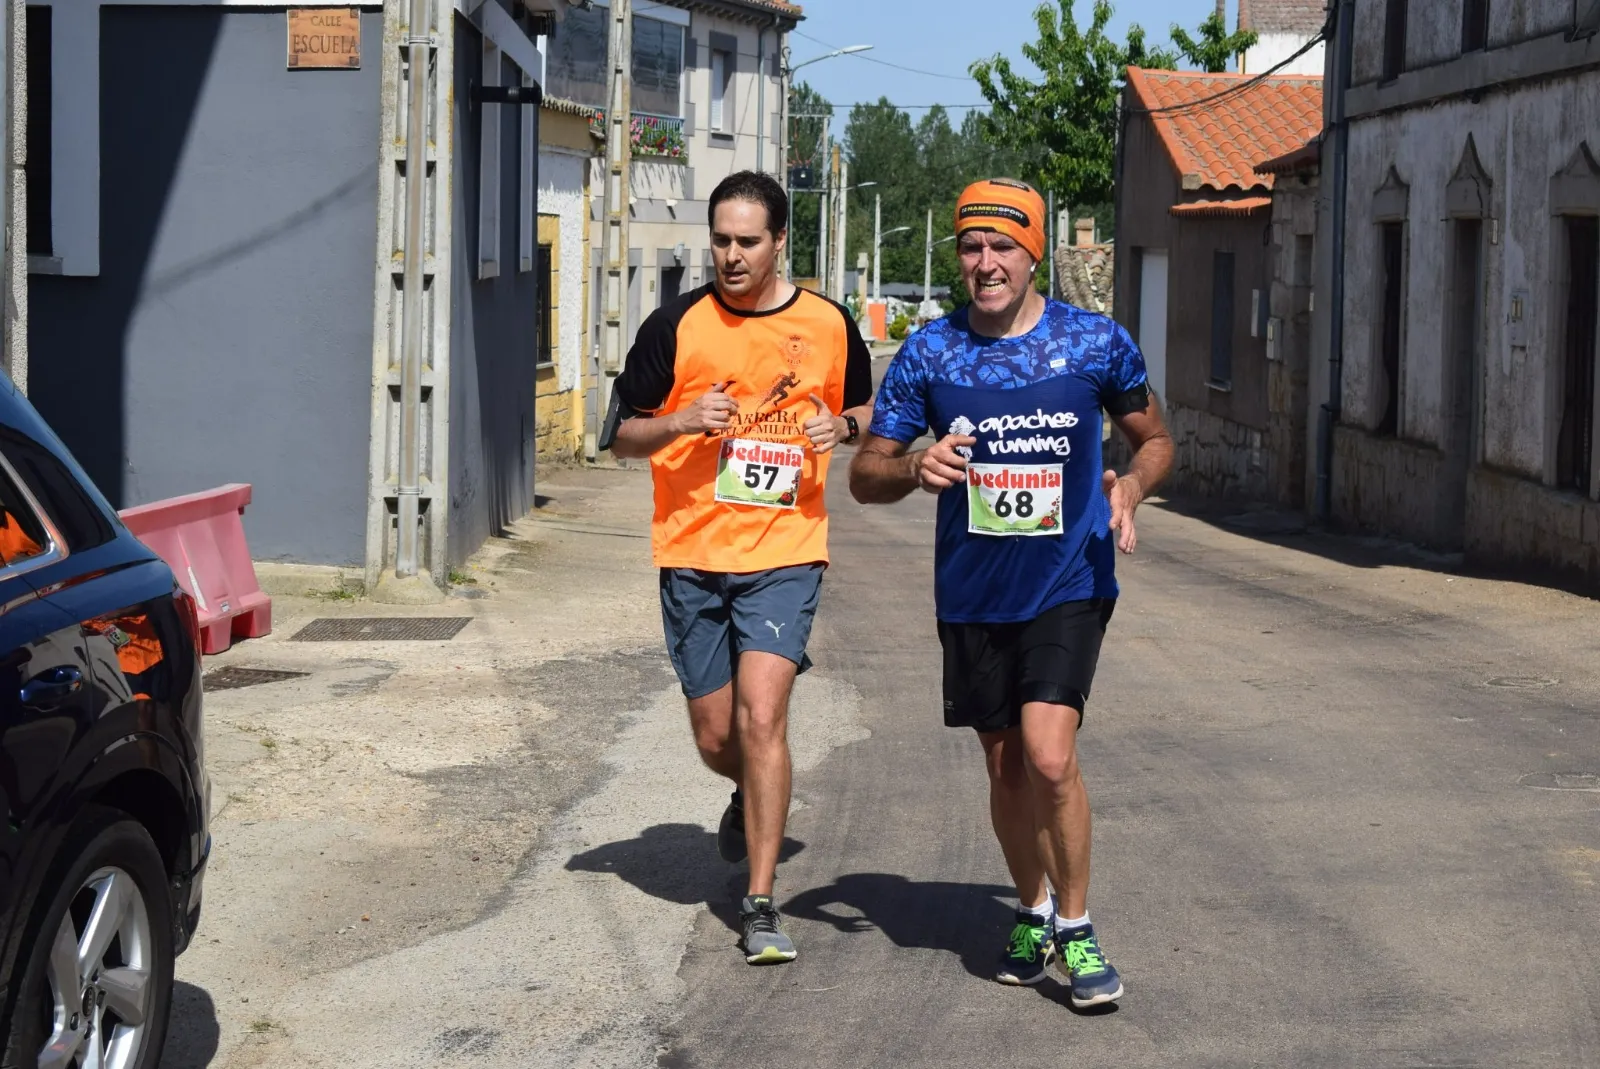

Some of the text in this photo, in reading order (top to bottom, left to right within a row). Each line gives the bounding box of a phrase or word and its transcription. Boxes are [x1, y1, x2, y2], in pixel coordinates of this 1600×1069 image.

[310, 15, 342, 27] CALLE
[292, 34, 360, 54] ESCUELA
[731, 409, 798, 426] ARRERA
[978, 408, 1079, 438] apaches
[721, 442, 802, 468] bedunia
[987, 434, 1071, 456] running
[744, 464, 779, 491] 57
[968, 467, 1060, 489] bedunia
[994, 491, 1034, 518] 68
